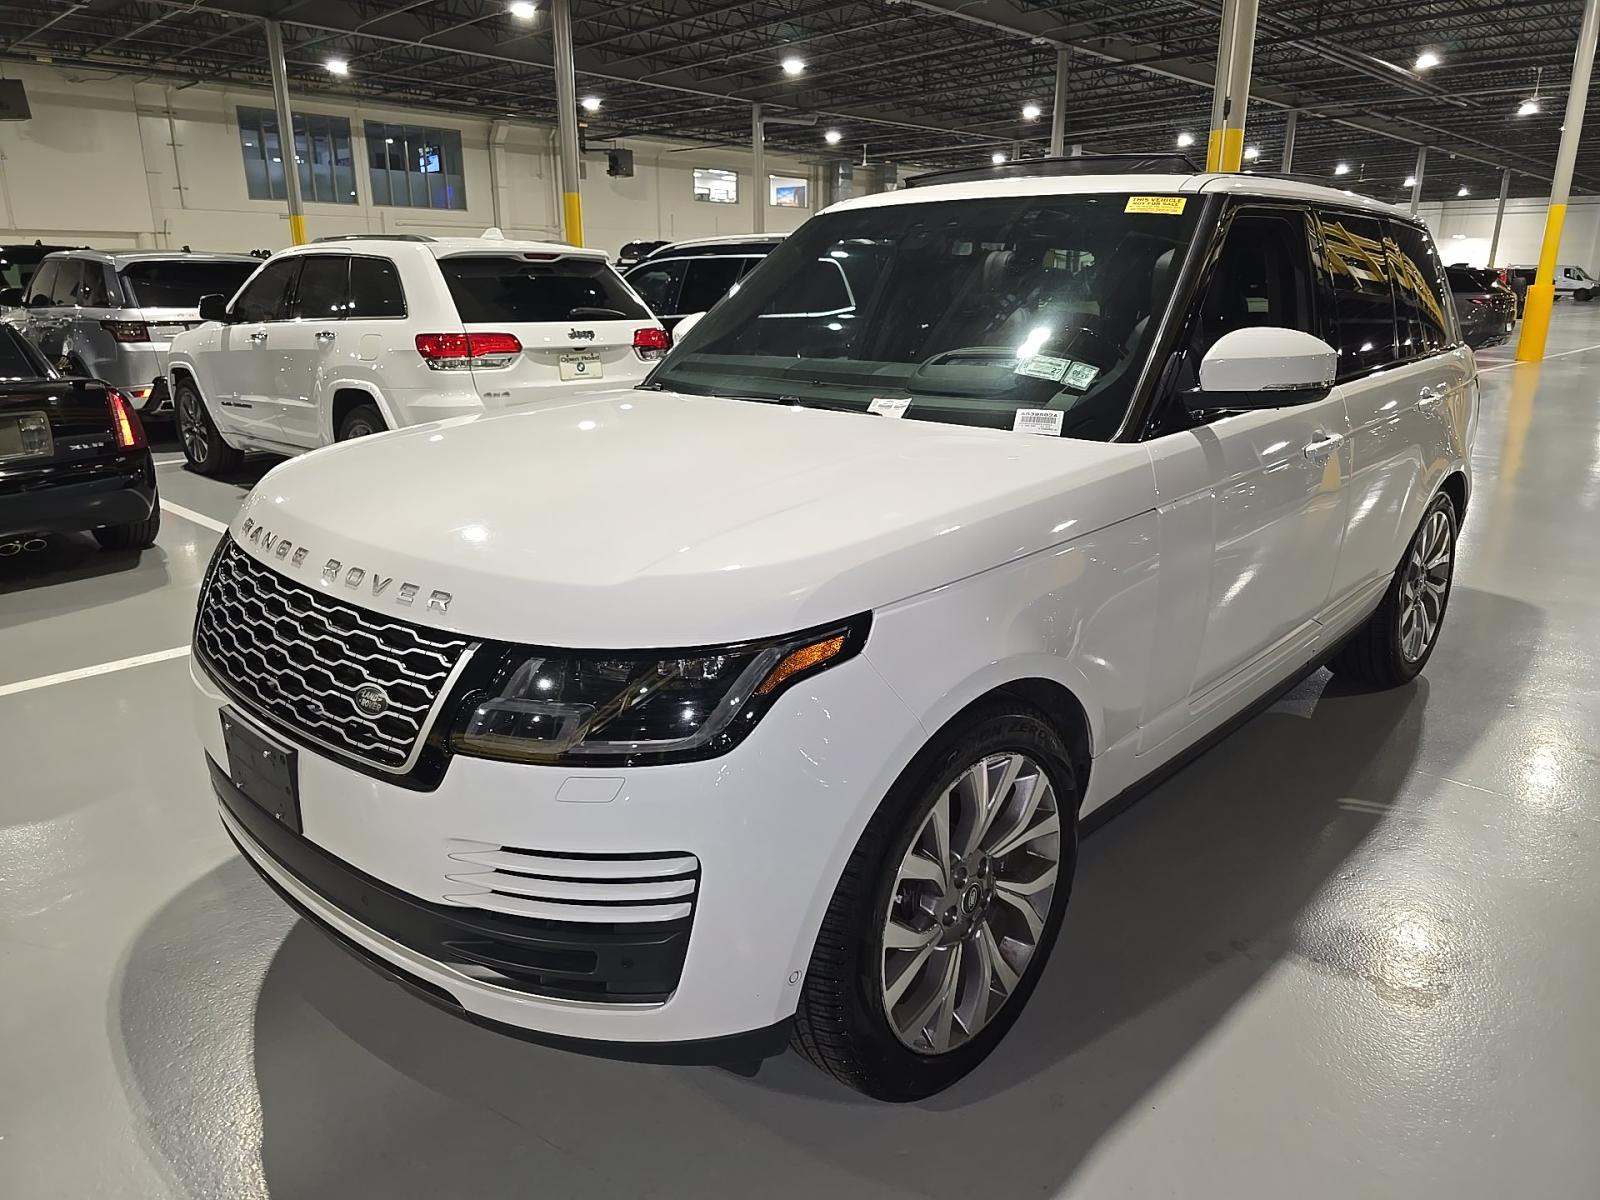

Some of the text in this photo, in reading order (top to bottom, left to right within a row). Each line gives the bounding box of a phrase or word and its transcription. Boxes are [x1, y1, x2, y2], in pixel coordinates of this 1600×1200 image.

[567, 328, 595, 341] Jeep
[241, 517, 453, 612] RANGE ROVER
